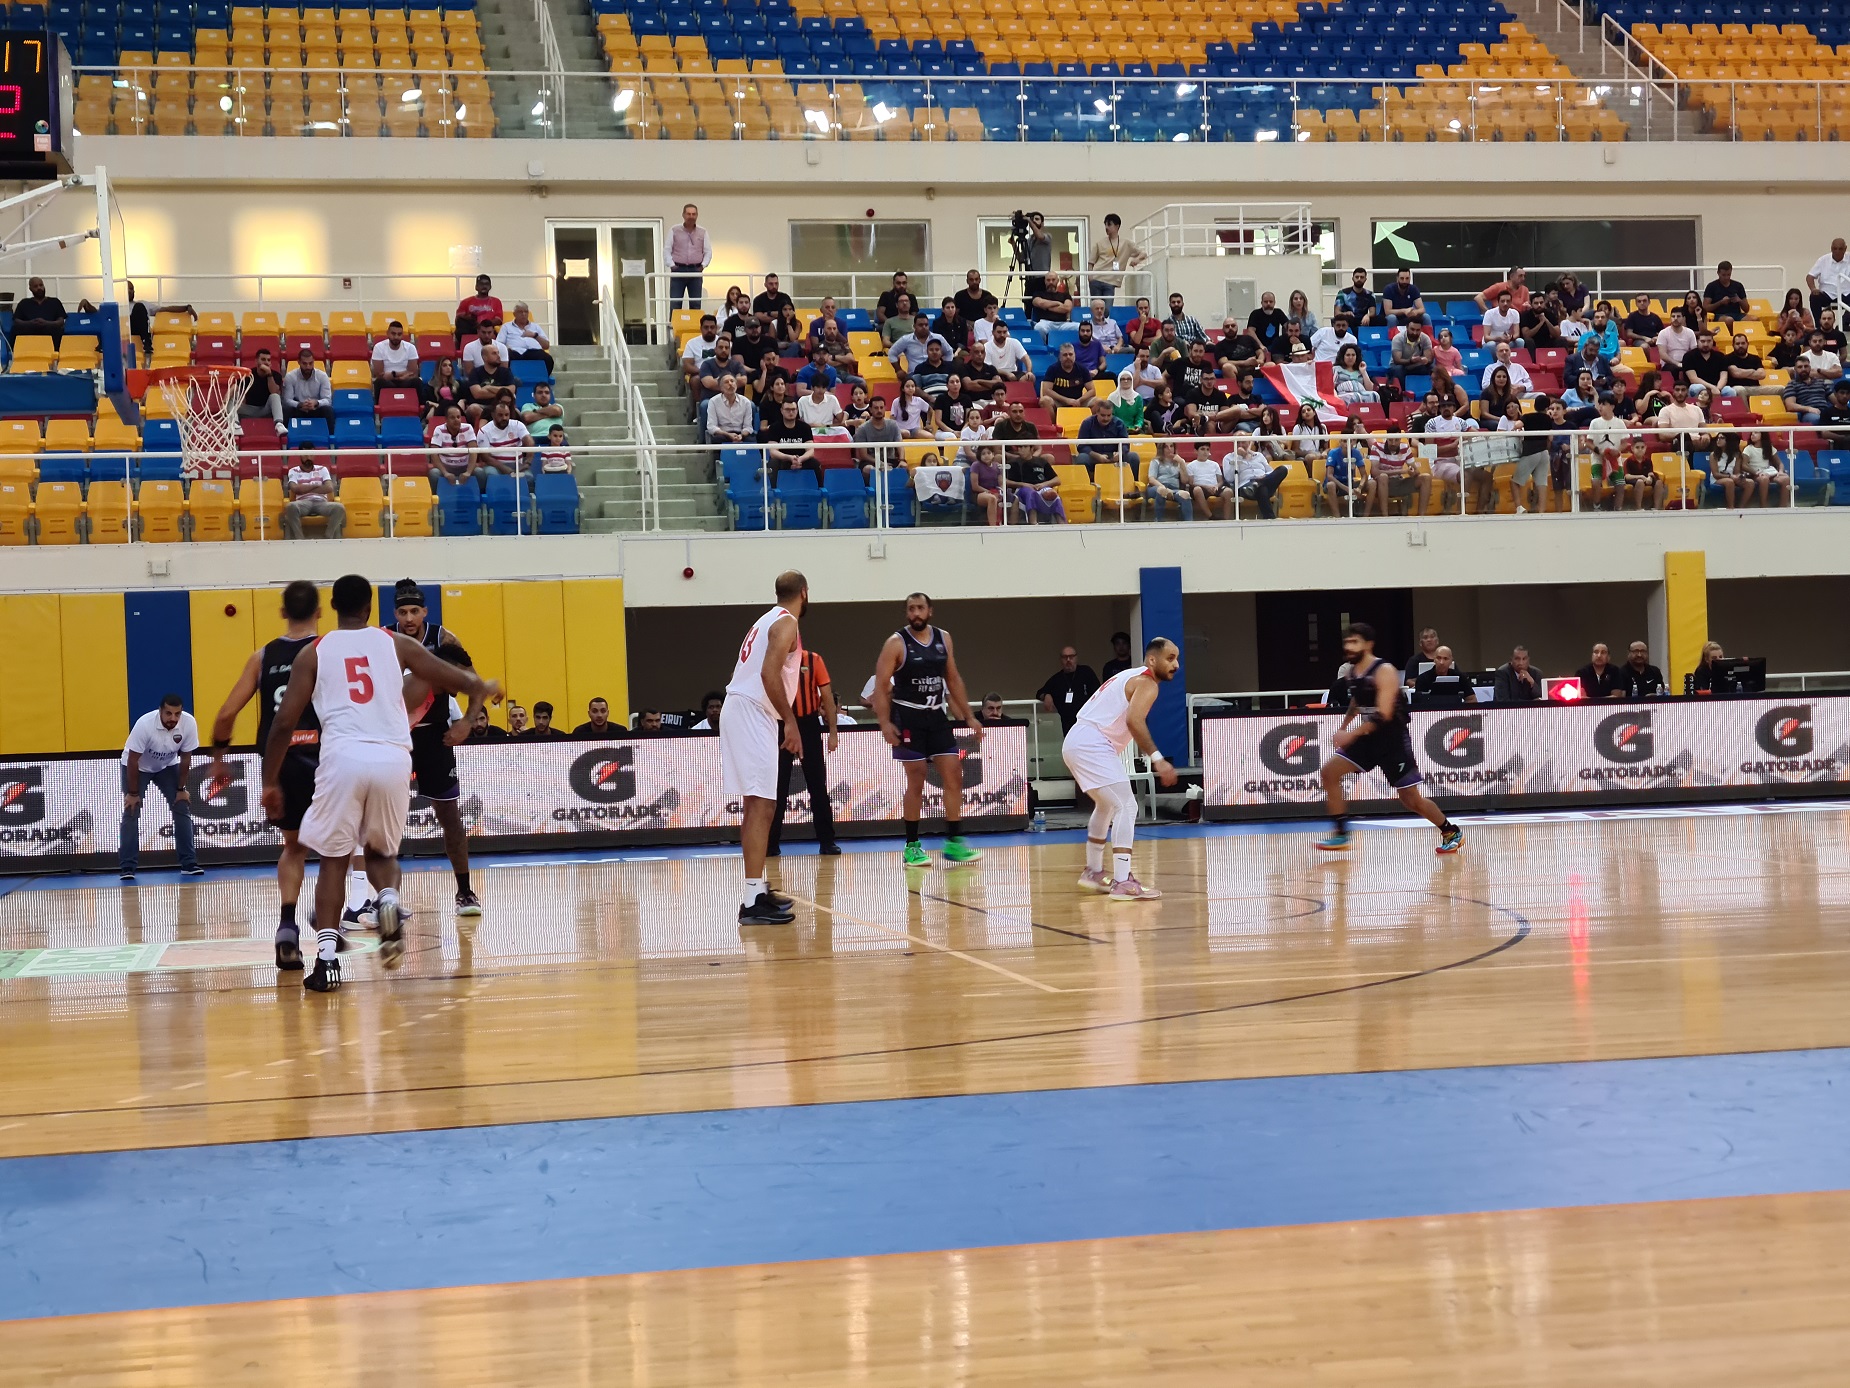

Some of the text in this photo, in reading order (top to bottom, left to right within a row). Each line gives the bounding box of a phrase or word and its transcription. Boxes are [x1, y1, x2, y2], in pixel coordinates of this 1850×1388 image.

[344, 655, 374, 705] 5
[661, 713, 683, 726] EIRUT
[1580, 764, 1677, 780] GATORADE
[1741, 758, 1836, 773] GATORADE
[1423, 769, 1508, 784] ATORADE
[1244, 780, 1321, 793] GATORA
[552, 804, 661, 821] GATORADE
[158, 821, 274, 837] GTORADE
